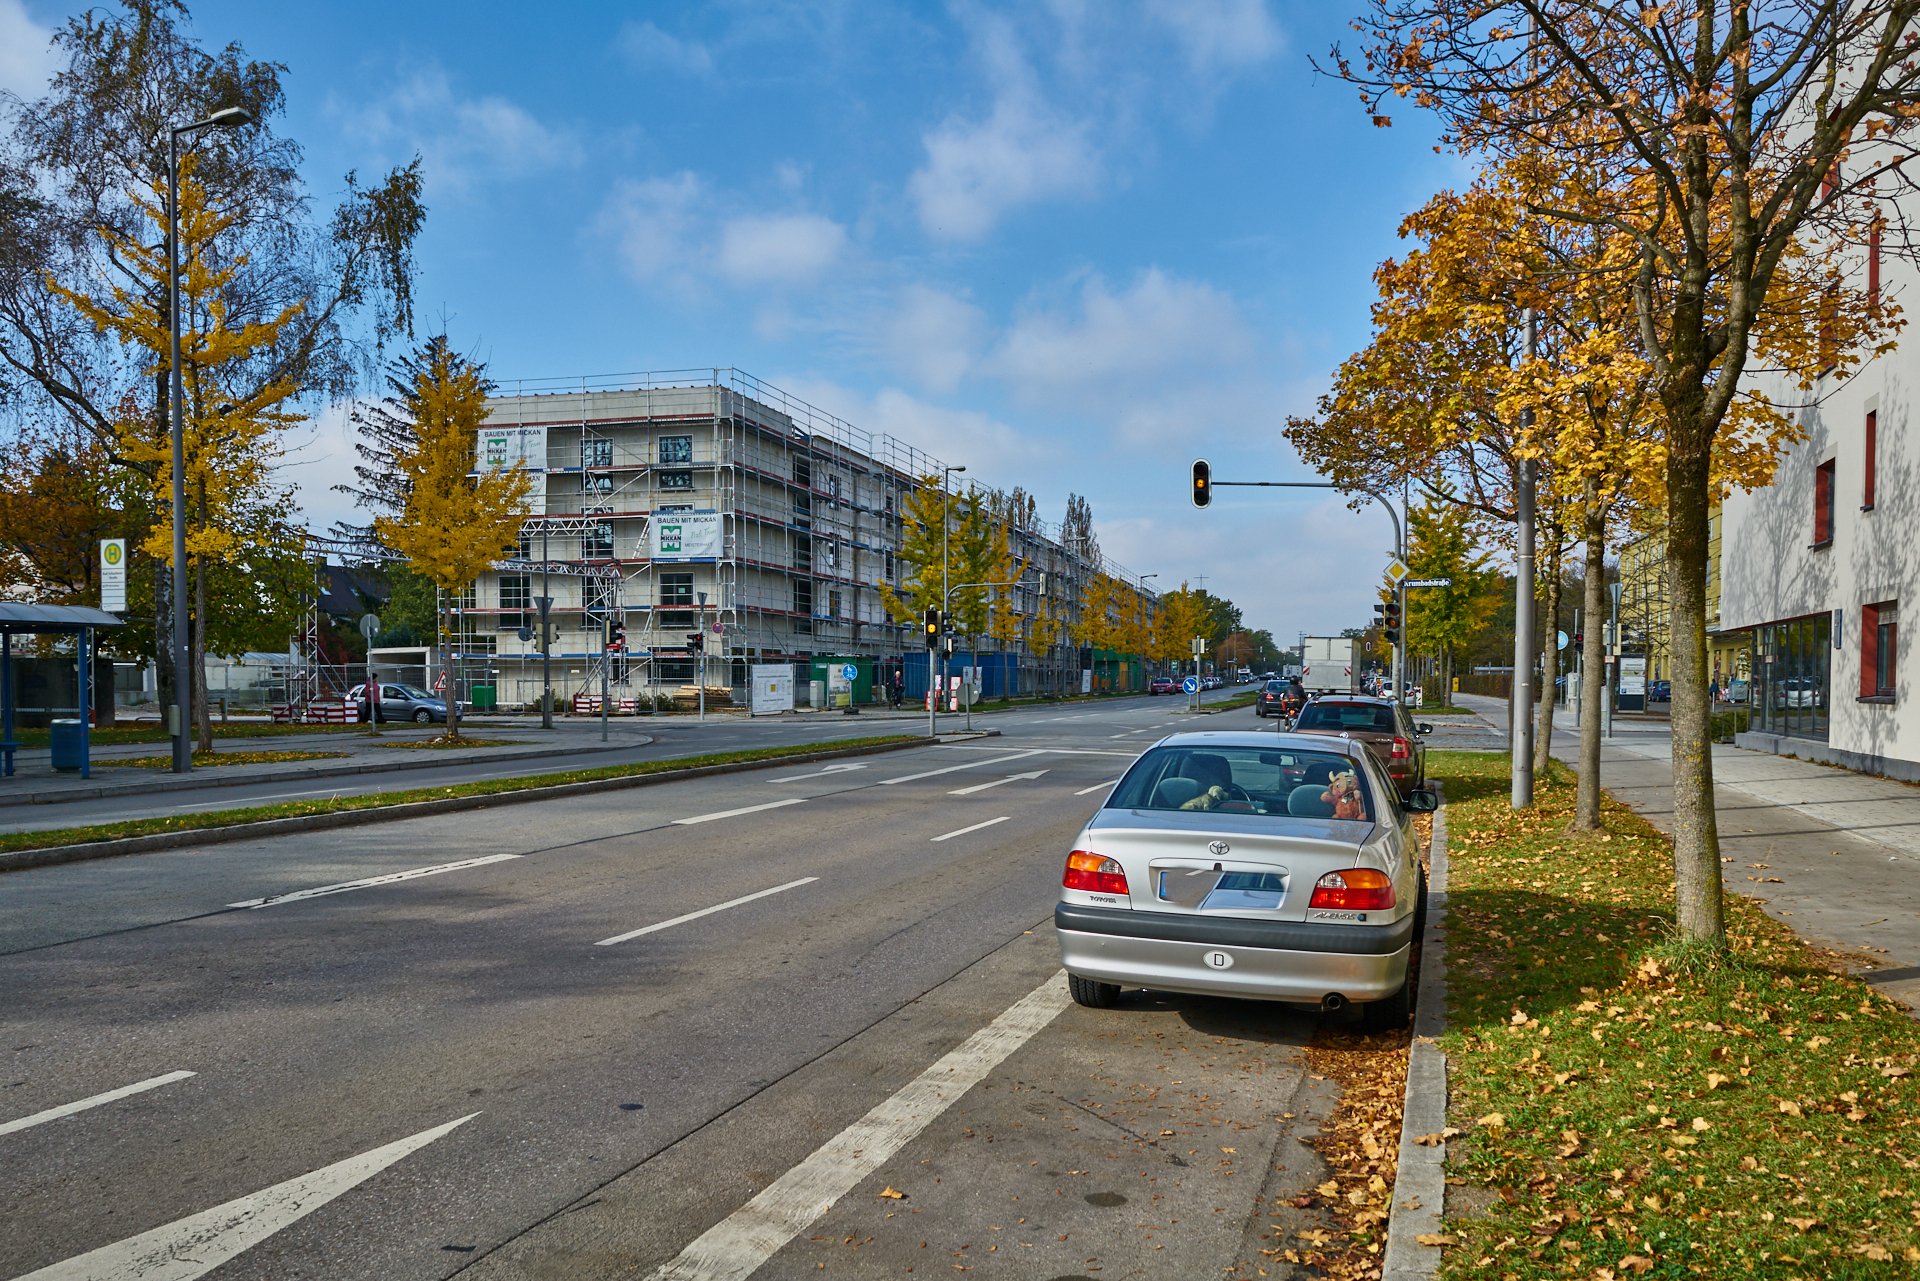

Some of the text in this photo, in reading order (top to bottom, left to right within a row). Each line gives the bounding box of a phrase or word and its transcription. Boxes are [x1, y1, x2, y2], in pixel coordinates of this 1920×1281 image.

[485, 430, 505, 438] BAUEN
[109, 548, 117, 560] H
[1089, 895, 1117, 904] TOYOTA
[1312, 911, 1357, 920] AVENSIS
[1214, 954, 1225, 967] D
